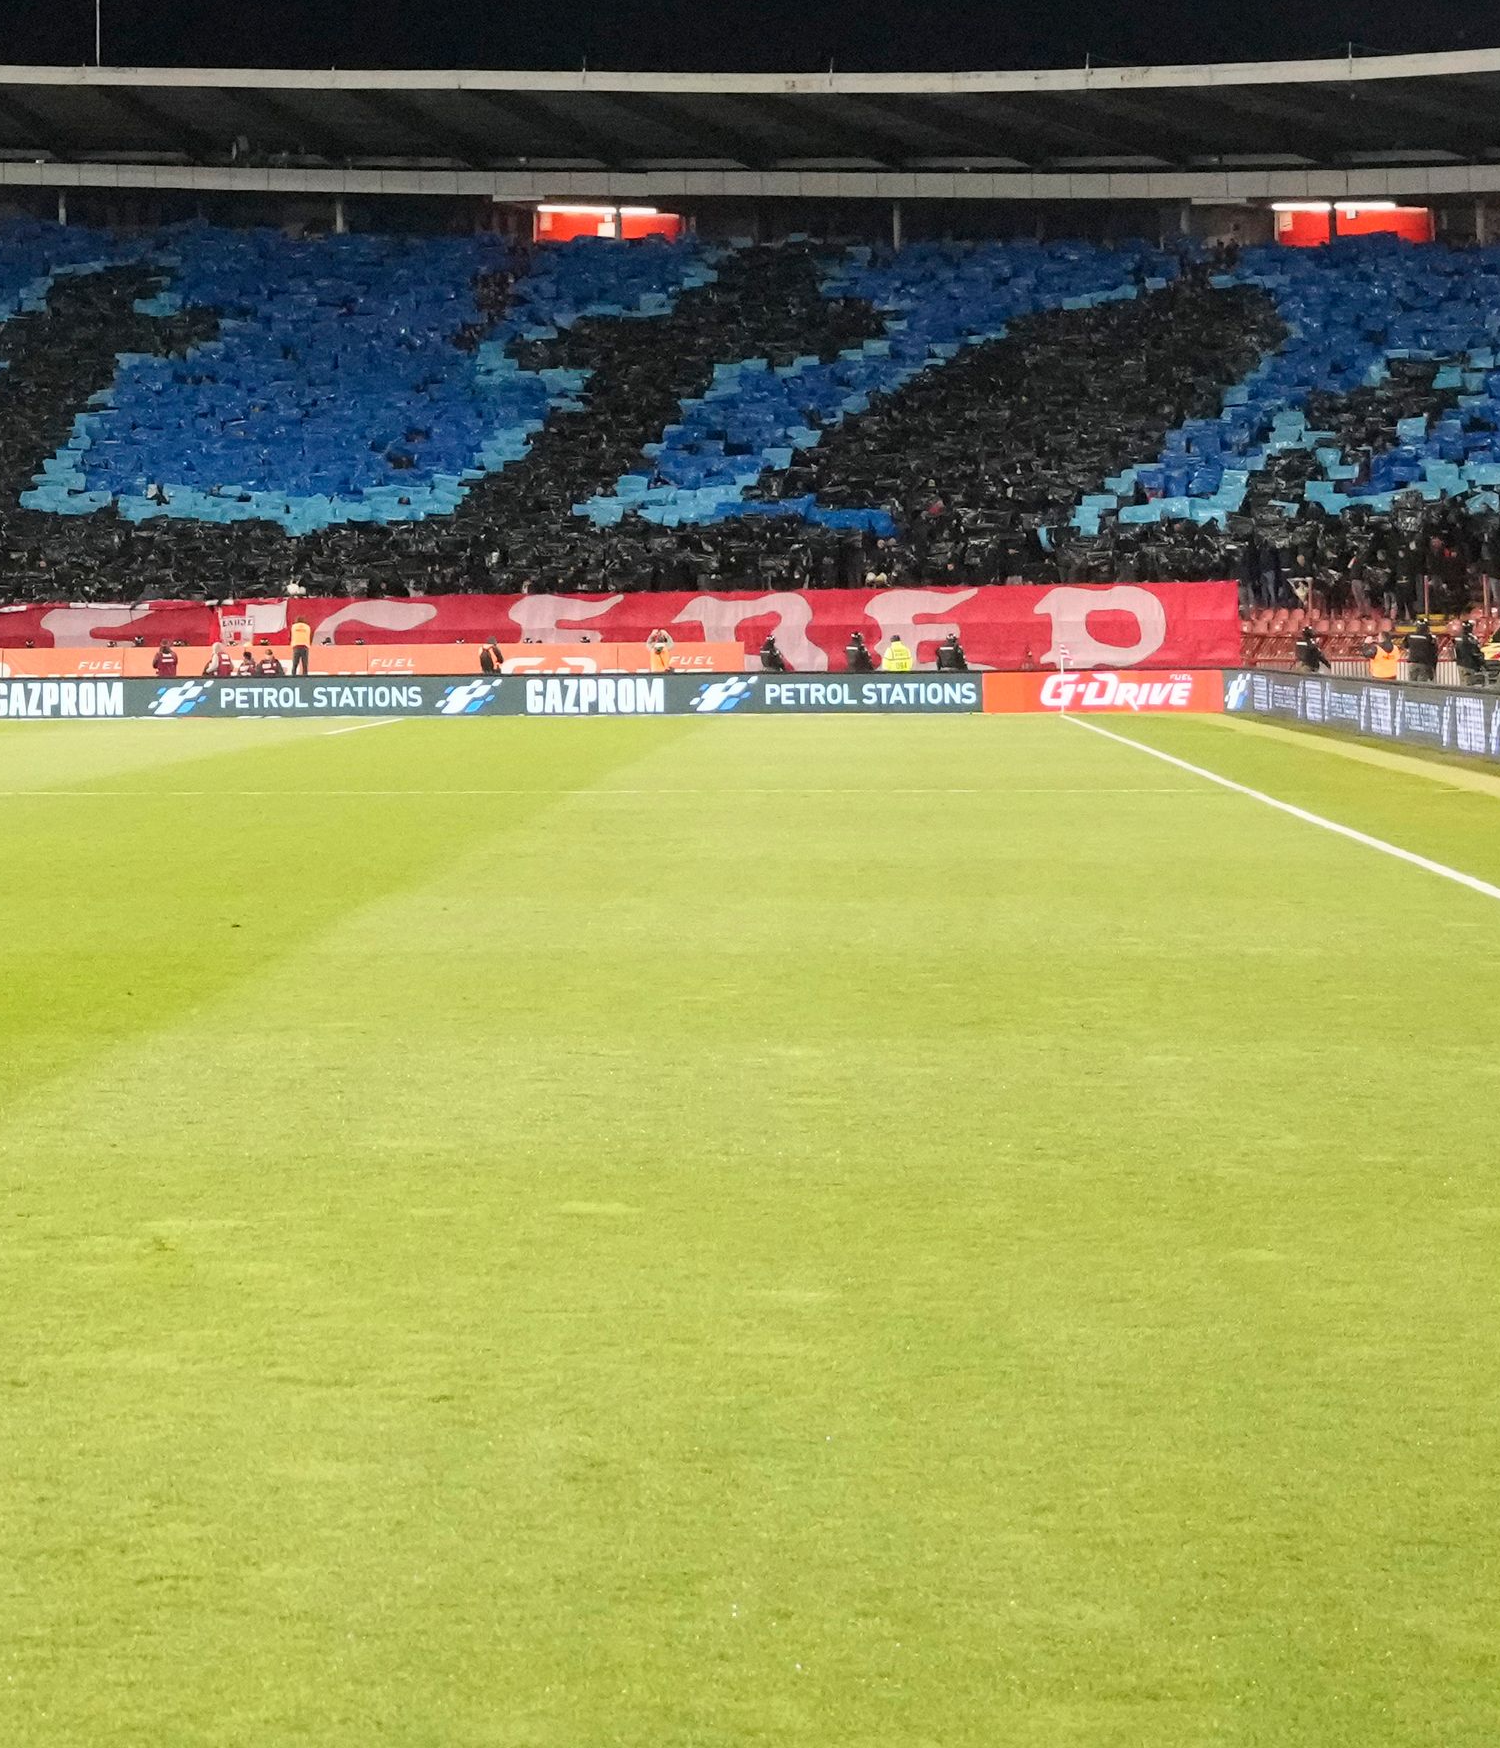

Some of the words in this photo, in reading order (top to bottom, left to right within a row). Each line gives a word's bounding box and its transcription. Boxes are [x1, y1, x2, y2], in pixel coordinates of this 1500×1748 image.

[78, 661, 122, 670] FUEL
[370, 658, 415, 668] FUEL
[669, 655, 714, 665] FUEL
[220, 687, 301, 708] PETROL
[312, 686, 423, 708] STATIONS
[526, 678, 664, 714] GAZPROM
[765, 684, 857, 705] PETROL
[862, 682, 977, 704] STATIONS
